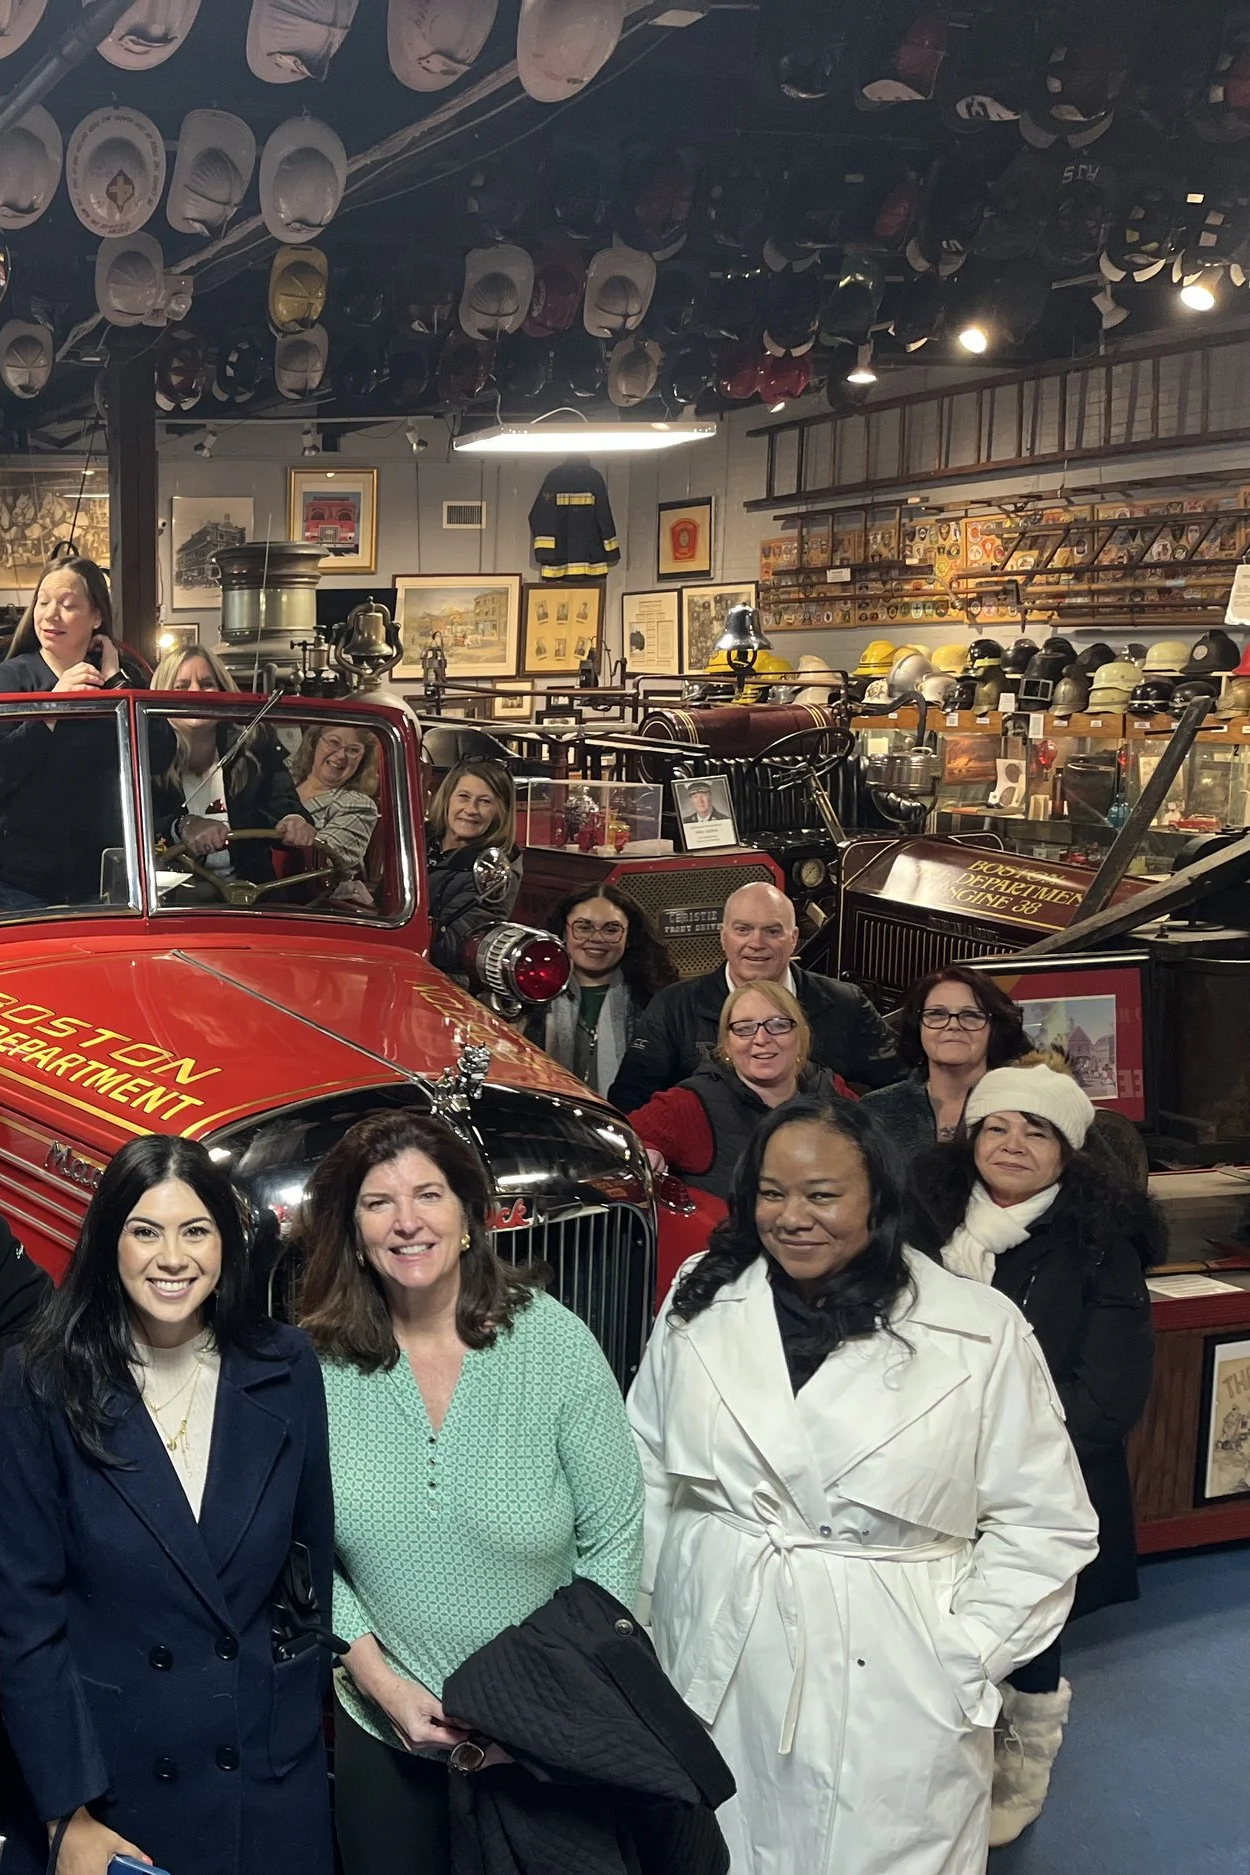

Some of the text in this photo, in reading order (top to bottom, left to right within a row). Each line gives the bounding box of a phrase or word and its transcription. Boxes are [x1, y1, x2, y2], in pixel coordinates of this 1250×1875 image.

[967, 859, 1066, 886] BOSTON
[944, 885, 1043, 915] NGINE 38
[954, 872, 1085, 907] DEPARTMEN
[43, 1140, 104, 1192] Mac
